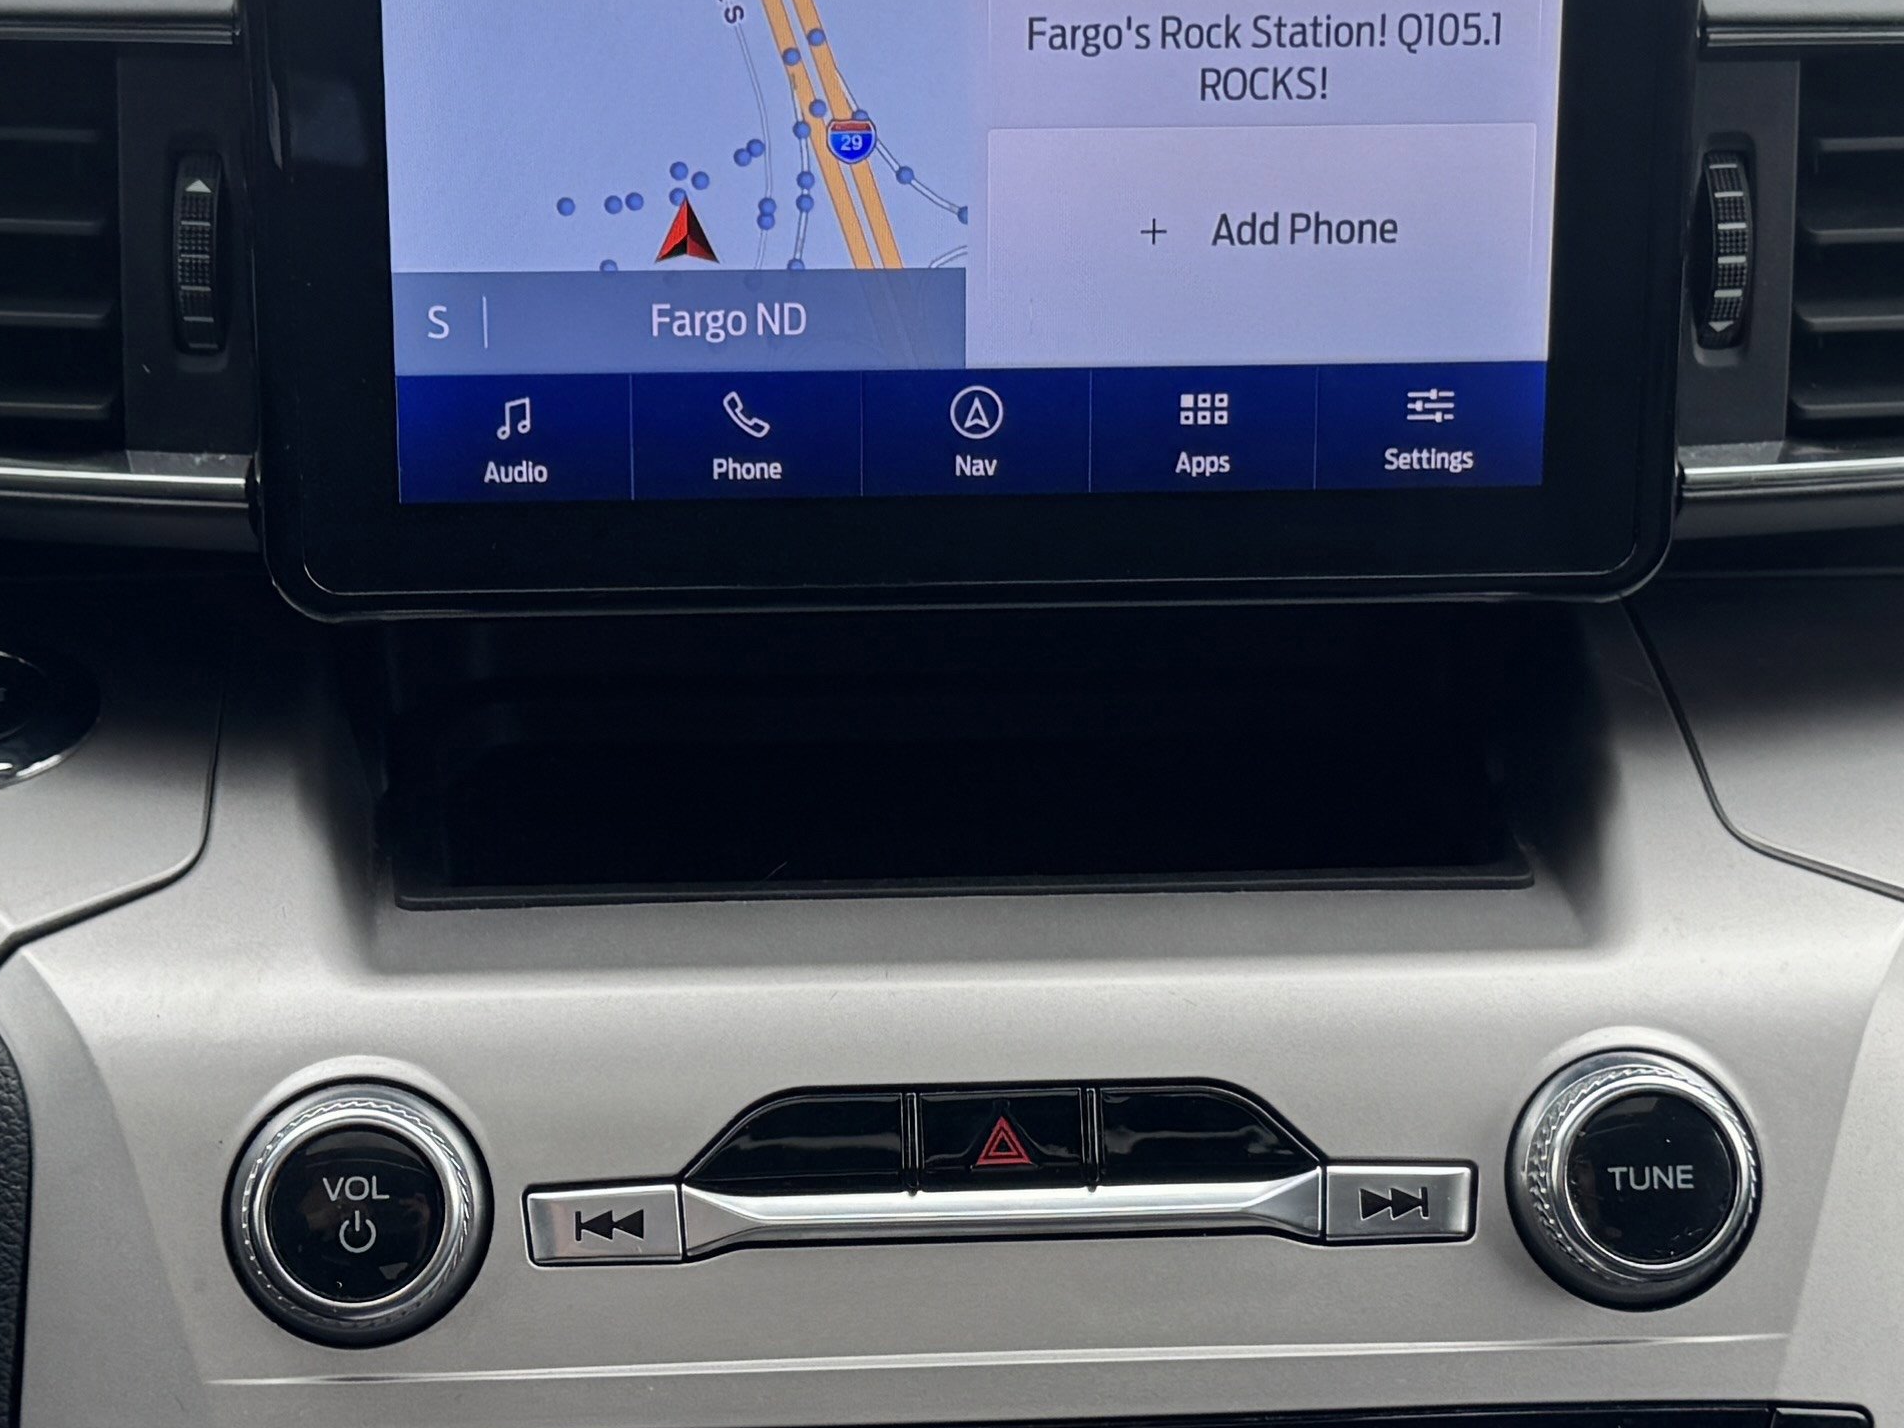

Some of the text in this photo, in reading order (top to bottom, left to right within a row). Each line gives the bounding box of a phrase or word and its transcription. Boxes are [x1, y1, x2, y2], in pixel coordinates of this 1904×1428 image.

[723, 4, 745, 25] S
[1028, 12, 1502, 58] Fargo's Rock Station! Q105.1
[1200, 66, 1327, 102] ROCKS!
[840, 134, 864, 152] 29
[1211, 210, 1398, 246] Add Phone
[427, 305, 450, 339] S
[652, 302, 807, 343] Fargo ND
[483, 460, 548, 483] Audio
[713, 457, 783, 480] Phone
[955, 454, 998, 477] Nav
[1175, 451, 1231, 478] Apps
[1384, 447, 1474, 473] Settings
[322, 1175, 390, 1202] VOL
[1607, 1164, 1695, 1191] TUNE
